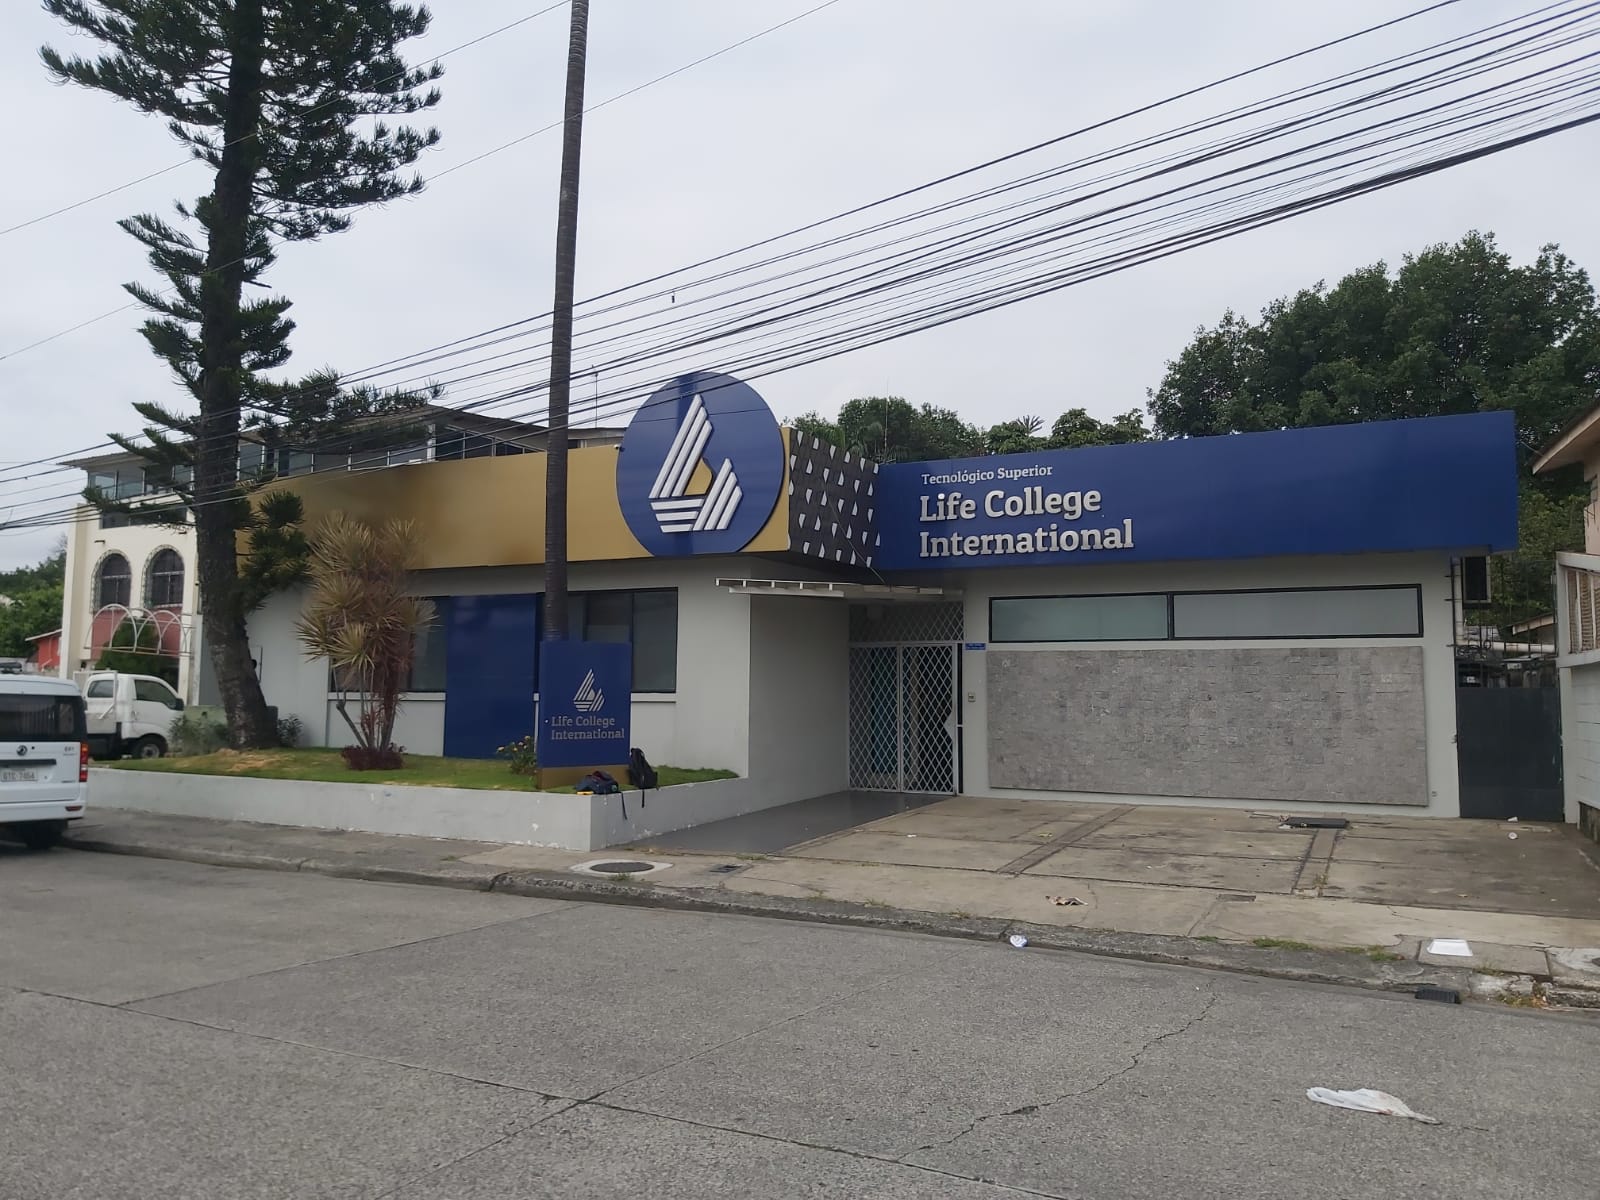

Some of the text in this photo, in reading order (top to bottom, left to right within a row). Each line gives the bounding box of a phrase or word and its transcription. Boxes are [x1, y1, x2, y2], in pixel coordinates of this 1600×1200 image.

[921, 464, 1053, 485] Tecnológico Superior
[919, 486, 1102, 522] Life College
[919, 518, 1135, 558] International
[551, 716, 615, 728] Life College
[551, 728, 625, 740] International
